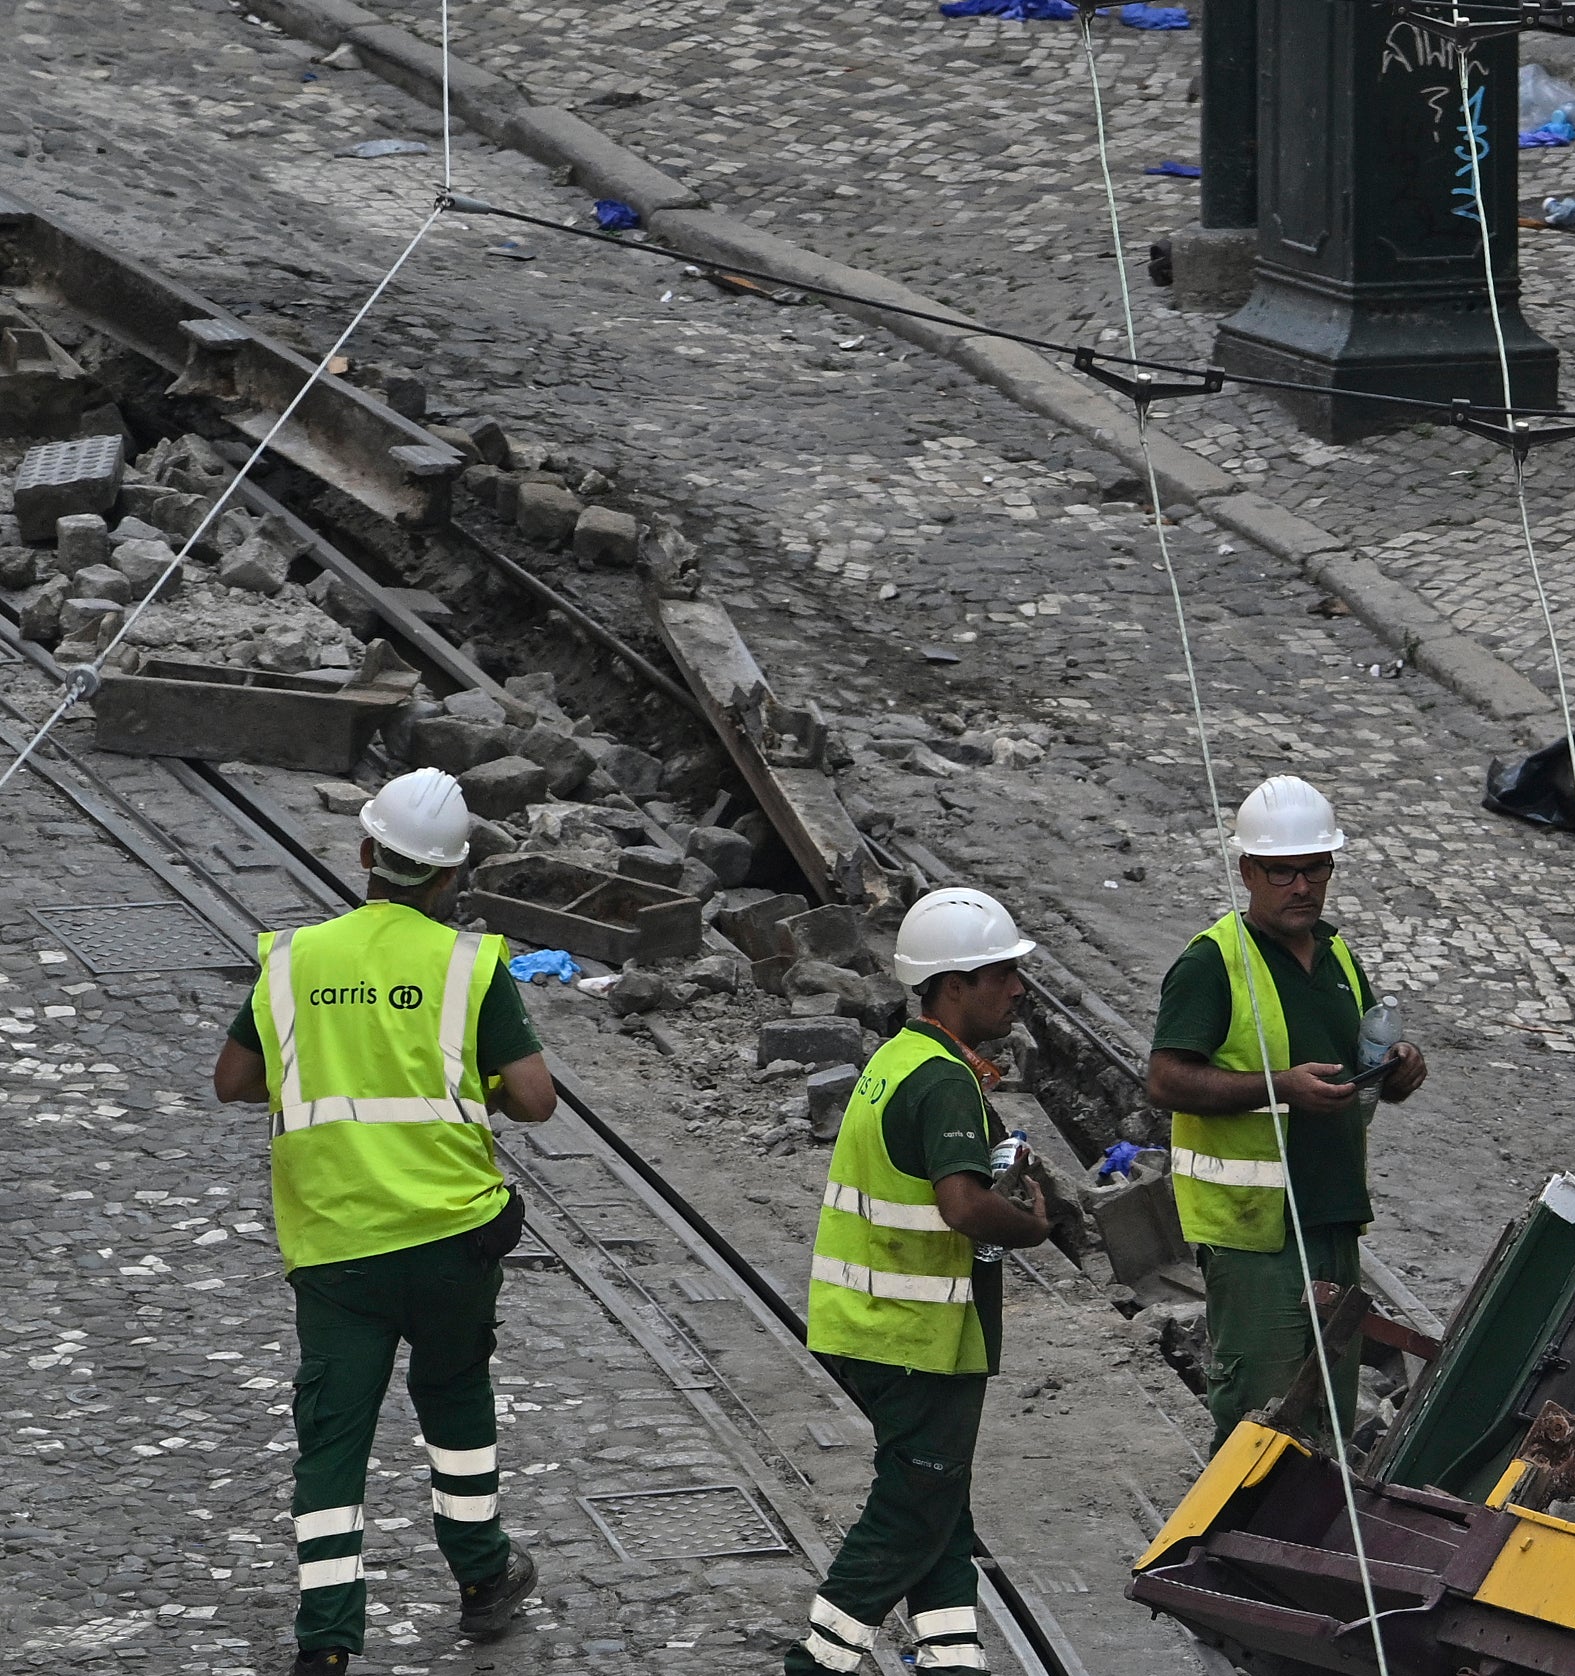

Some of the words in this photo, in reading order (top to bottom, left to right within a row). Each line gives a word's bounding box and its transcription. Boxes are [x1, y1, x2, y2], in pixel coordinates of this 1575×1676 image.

[310, 981, 377, 1007] carris
[943, 1130, 964, 1138] carris
[912, 1458, 932, 1468] carris
